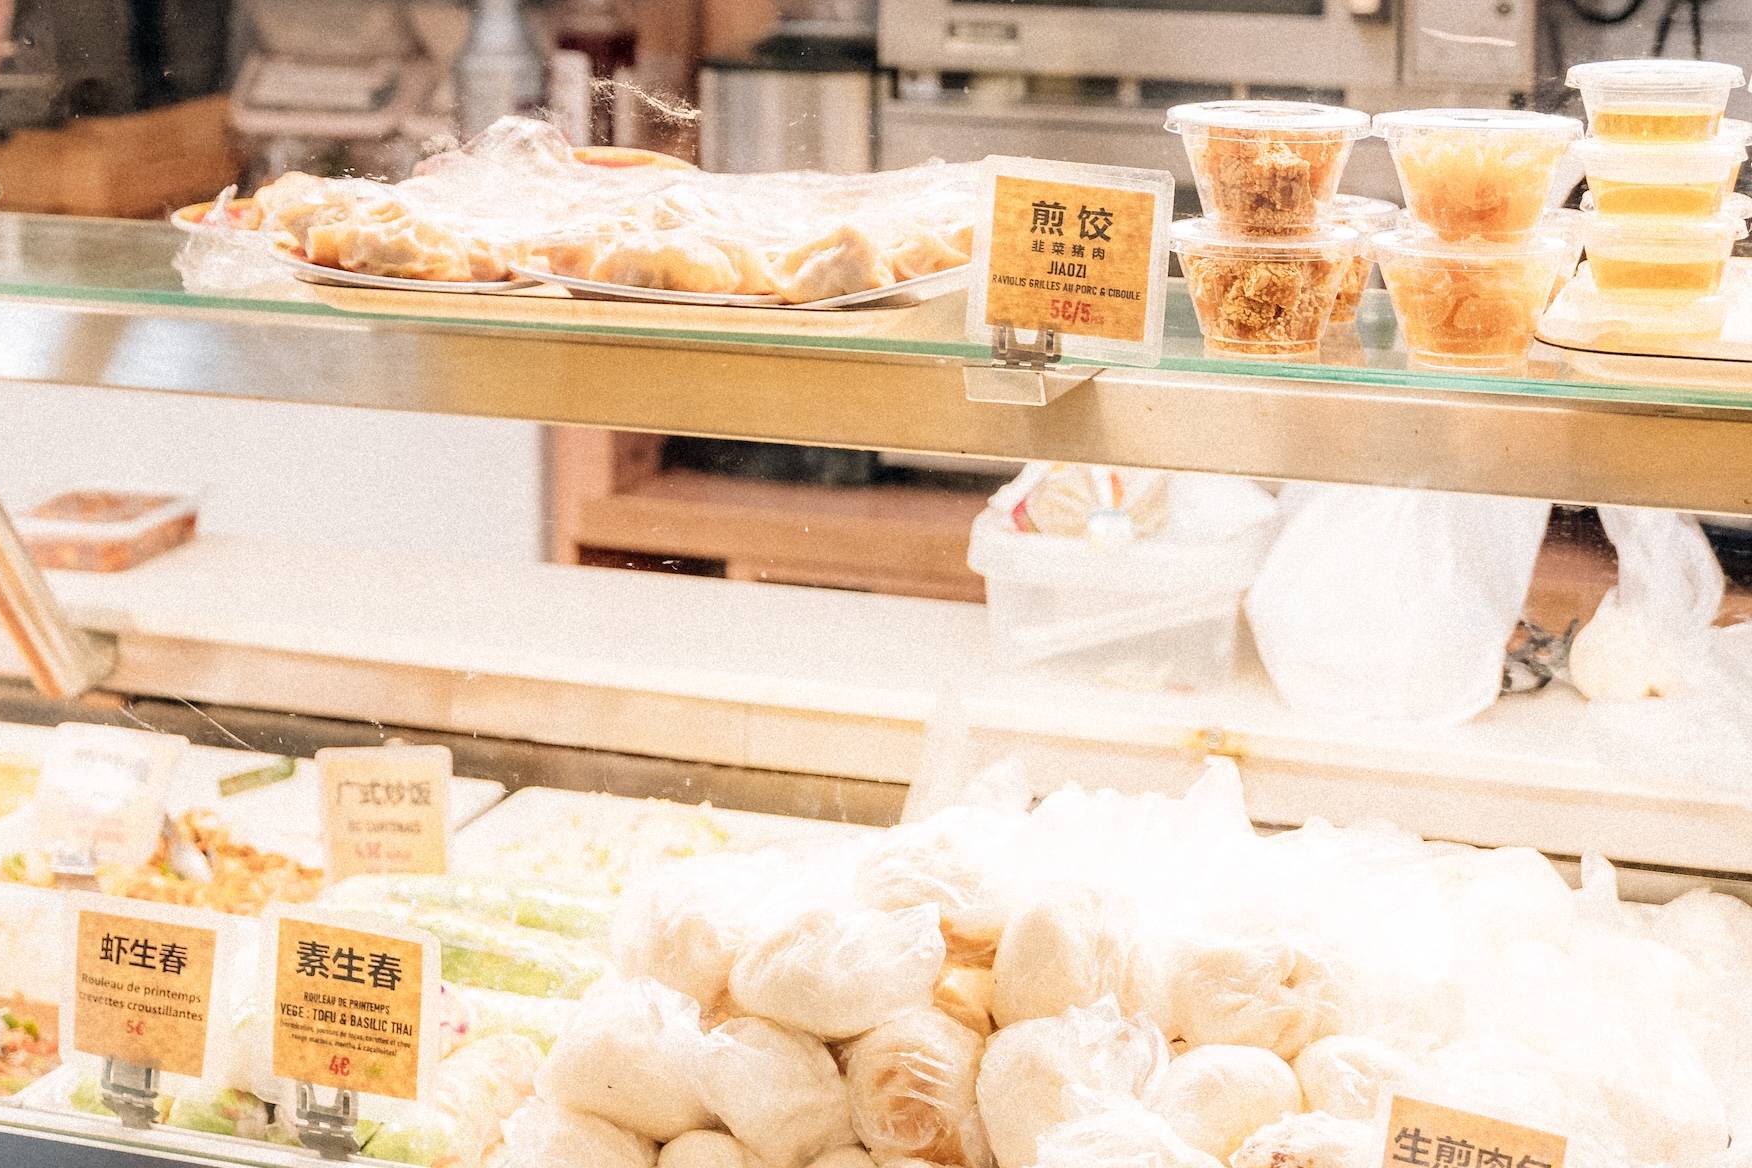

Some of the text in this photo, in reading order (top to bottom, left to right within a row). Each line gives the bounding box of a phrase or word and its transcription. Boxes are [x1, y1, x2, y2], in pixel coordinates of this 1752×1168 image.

[1030, 200, 1114, 242] 煎饺
[1032, 239, 1105, 260] 韭菜猪肉
[1047, 260, 1087, 279] JIAOZI
[992, 274, 1141, 300] RAVIOLIS GRILLES AU PORC & CIBOULE
[99, 933, 188, 975] 虾生春
[296, 940, 402, 991] 素生春
[81, 973, 201, 1004] Rouleau de printemps
[79, 991, 203, 1021] crevettes croustillantes
[303, 992, 390, 1014] ROULEAU DE PRINTEMPS
[125, 1019, 145, 1036] 5€
[280, 1002, 304, 1018] VEGE
[312, 1008, 337, 1023] TOFU
[339, 1013, 347, 1026] &
[350, 1014, 388, 1032] BASILIC
[391, 1021, 413, 1036] THAI
[329, 1054, 351, 1077] 4€
